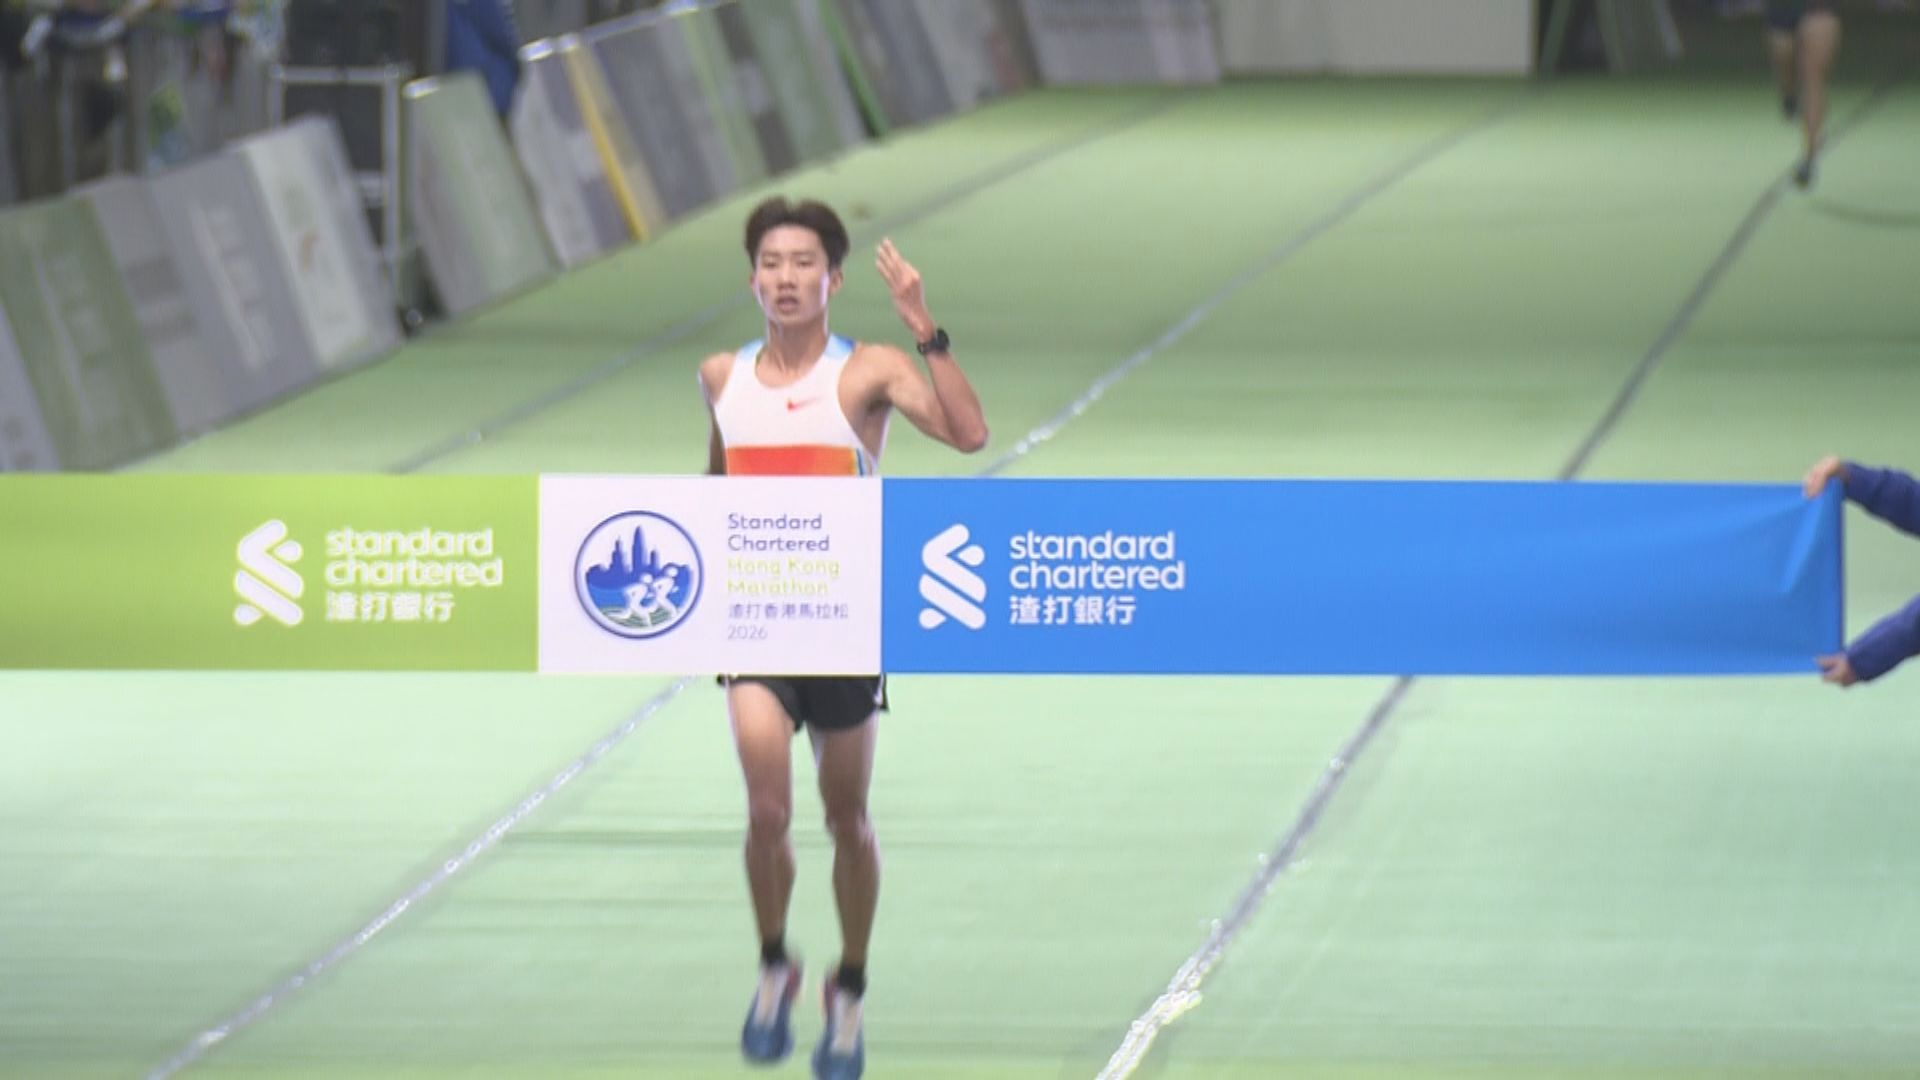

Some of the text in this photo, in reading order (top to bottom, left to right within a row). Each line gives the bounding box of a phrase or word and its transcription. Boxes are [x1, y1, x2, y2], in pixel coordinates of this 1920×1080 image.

[727, 513, 822, 530] Standard
[326, 526, 493, 556] standard
[727, 534, 830, 552] Chartered
[1009, 530, 1175, 560] standard
[326, 557, 503, 586] chartered
[727, 558, 840, 577] Hong Kong
[1009, 560, 1185, 590] chartered
[727, 578, 829, 596] Marathon
[326, 591, 455, 622] 渣打銀行
[728, 603, 849, 620] 渣打香港馬拉松
[1009, 595, 1136, 625] 渣打銀行
[727, 626, 768, 641] 2026
